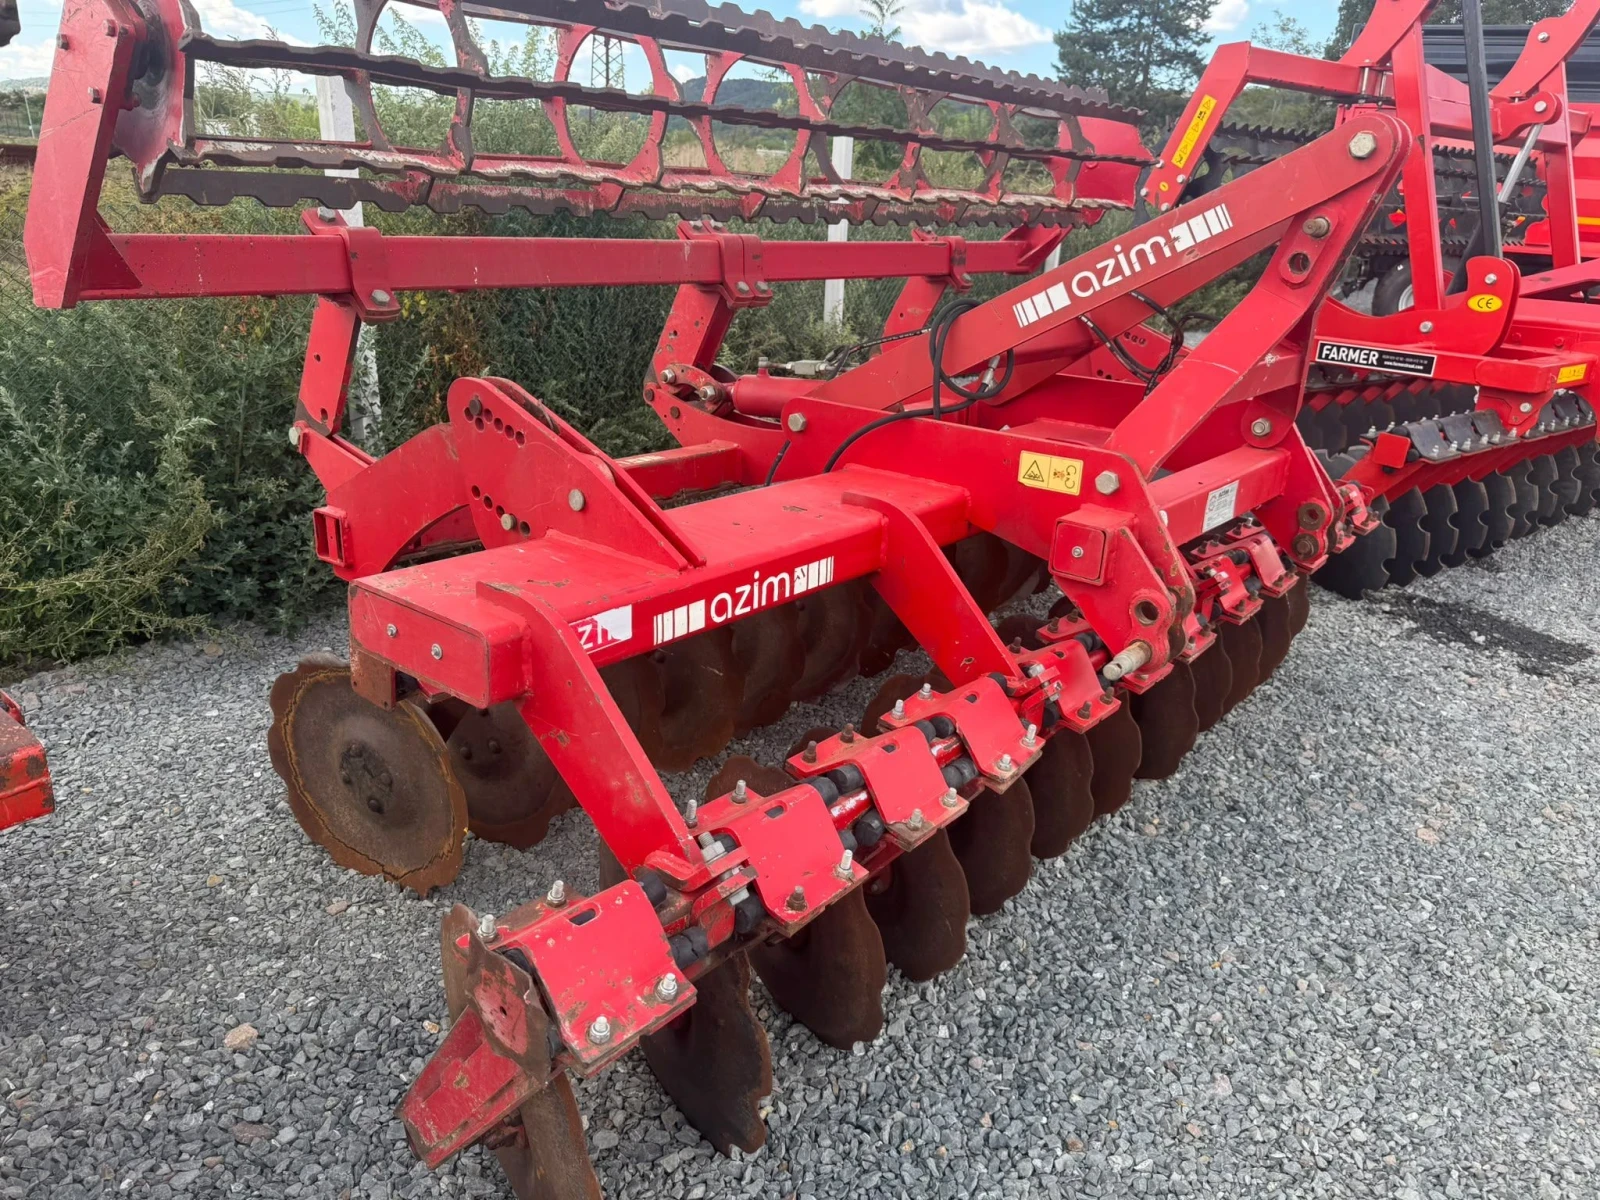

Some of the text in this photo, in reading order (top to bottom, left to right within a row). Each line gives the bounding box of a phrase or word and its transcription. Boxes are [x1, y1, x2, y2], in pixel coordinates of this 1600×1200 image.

[1071, 235, 1172, 298] azim
[1321, 345, 1379, 366] FARMER
[710, 570, 792, 624] azim
